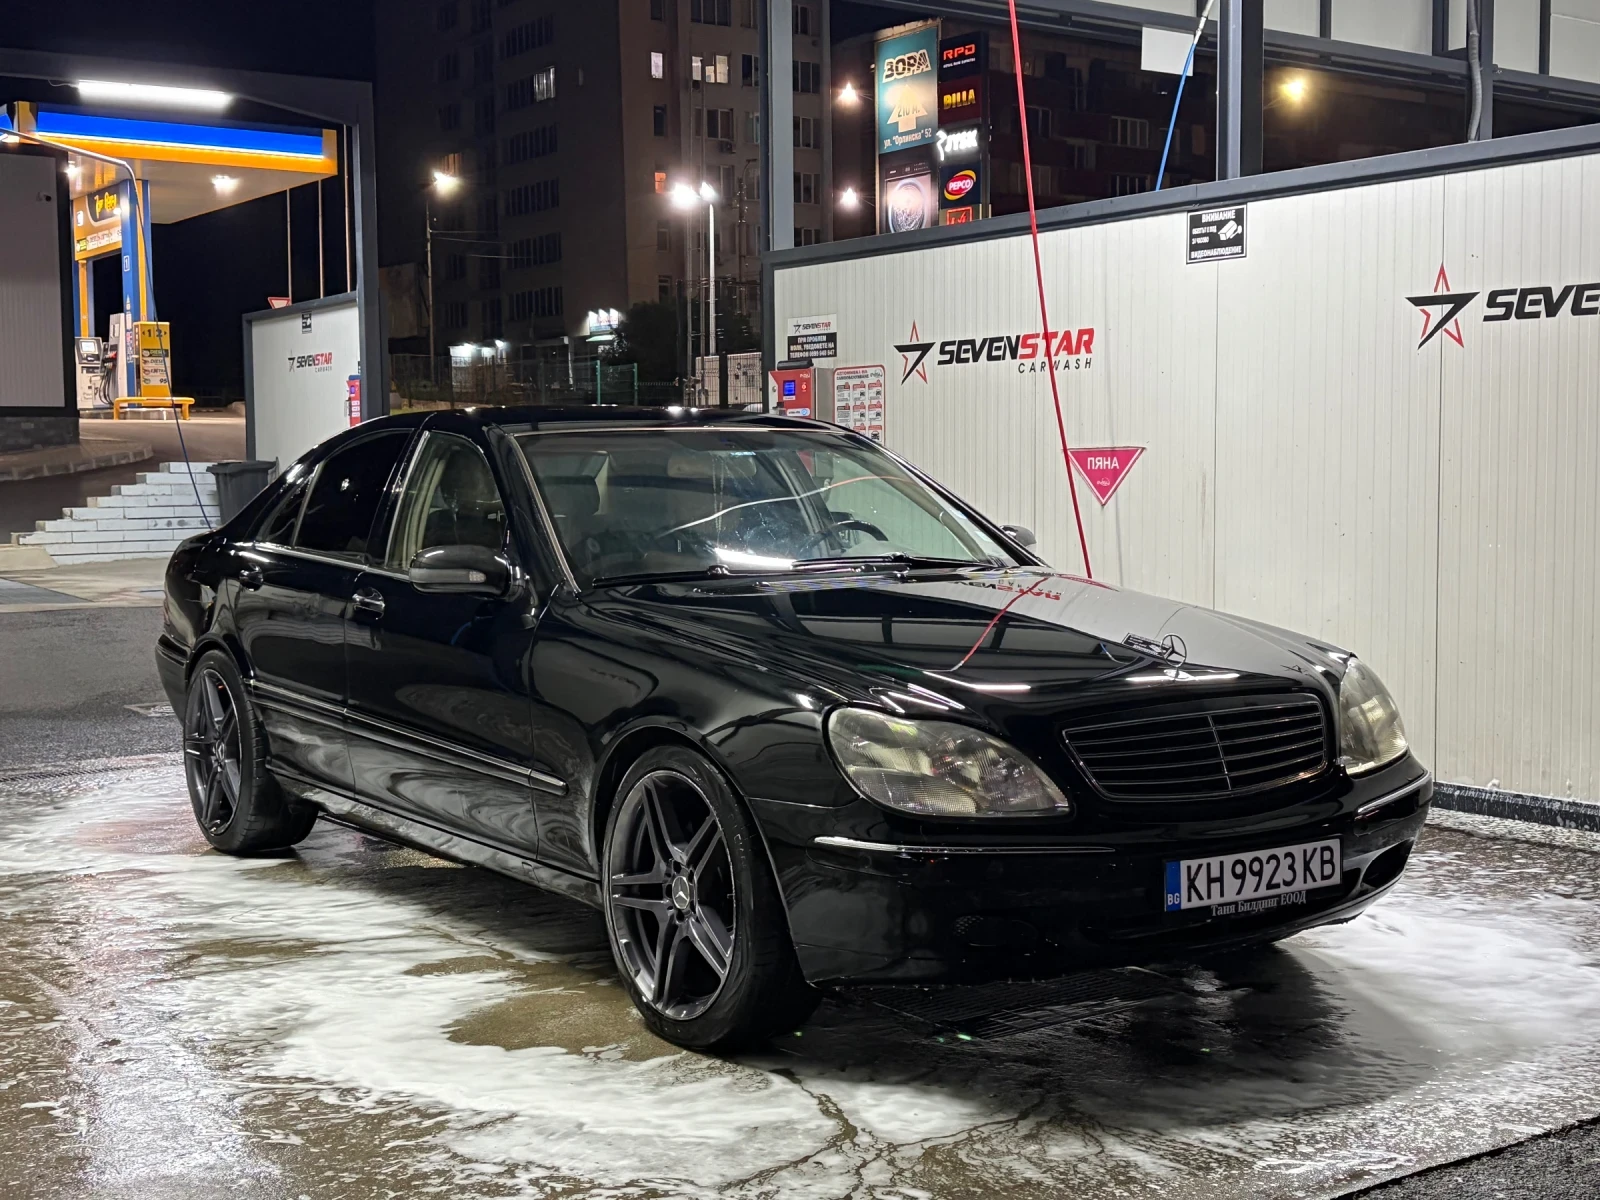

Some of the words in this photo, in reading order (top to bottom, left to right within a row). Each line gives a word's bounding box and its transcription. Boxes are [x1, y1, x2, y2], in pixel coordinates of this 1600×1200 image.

[943, 44, 976, 61] RPD
[924, 128, 932, 139] 52
[948, 179, 972, 192] PEPCO
[1202, 210, 1235, 223] ВНИМАНИЕ
[1483, 282, 1600, 322] SEVE
[147, 329, 152, 337] 1
[937, 328, 1095, 366] SEVENSTAR
[296, 352, 333, 368] SEVENSTAR
[1087, 456, 1120, 470] ПЯНА
[1231, 851, 1297, 896] 9923
[1167, 893, 1180, 906] BG
[1211, 901, 1236, 917] Таня
[1237, 896, 1278, 914] Билдинг
[1280, 890, 1307, 904] ЕООД
